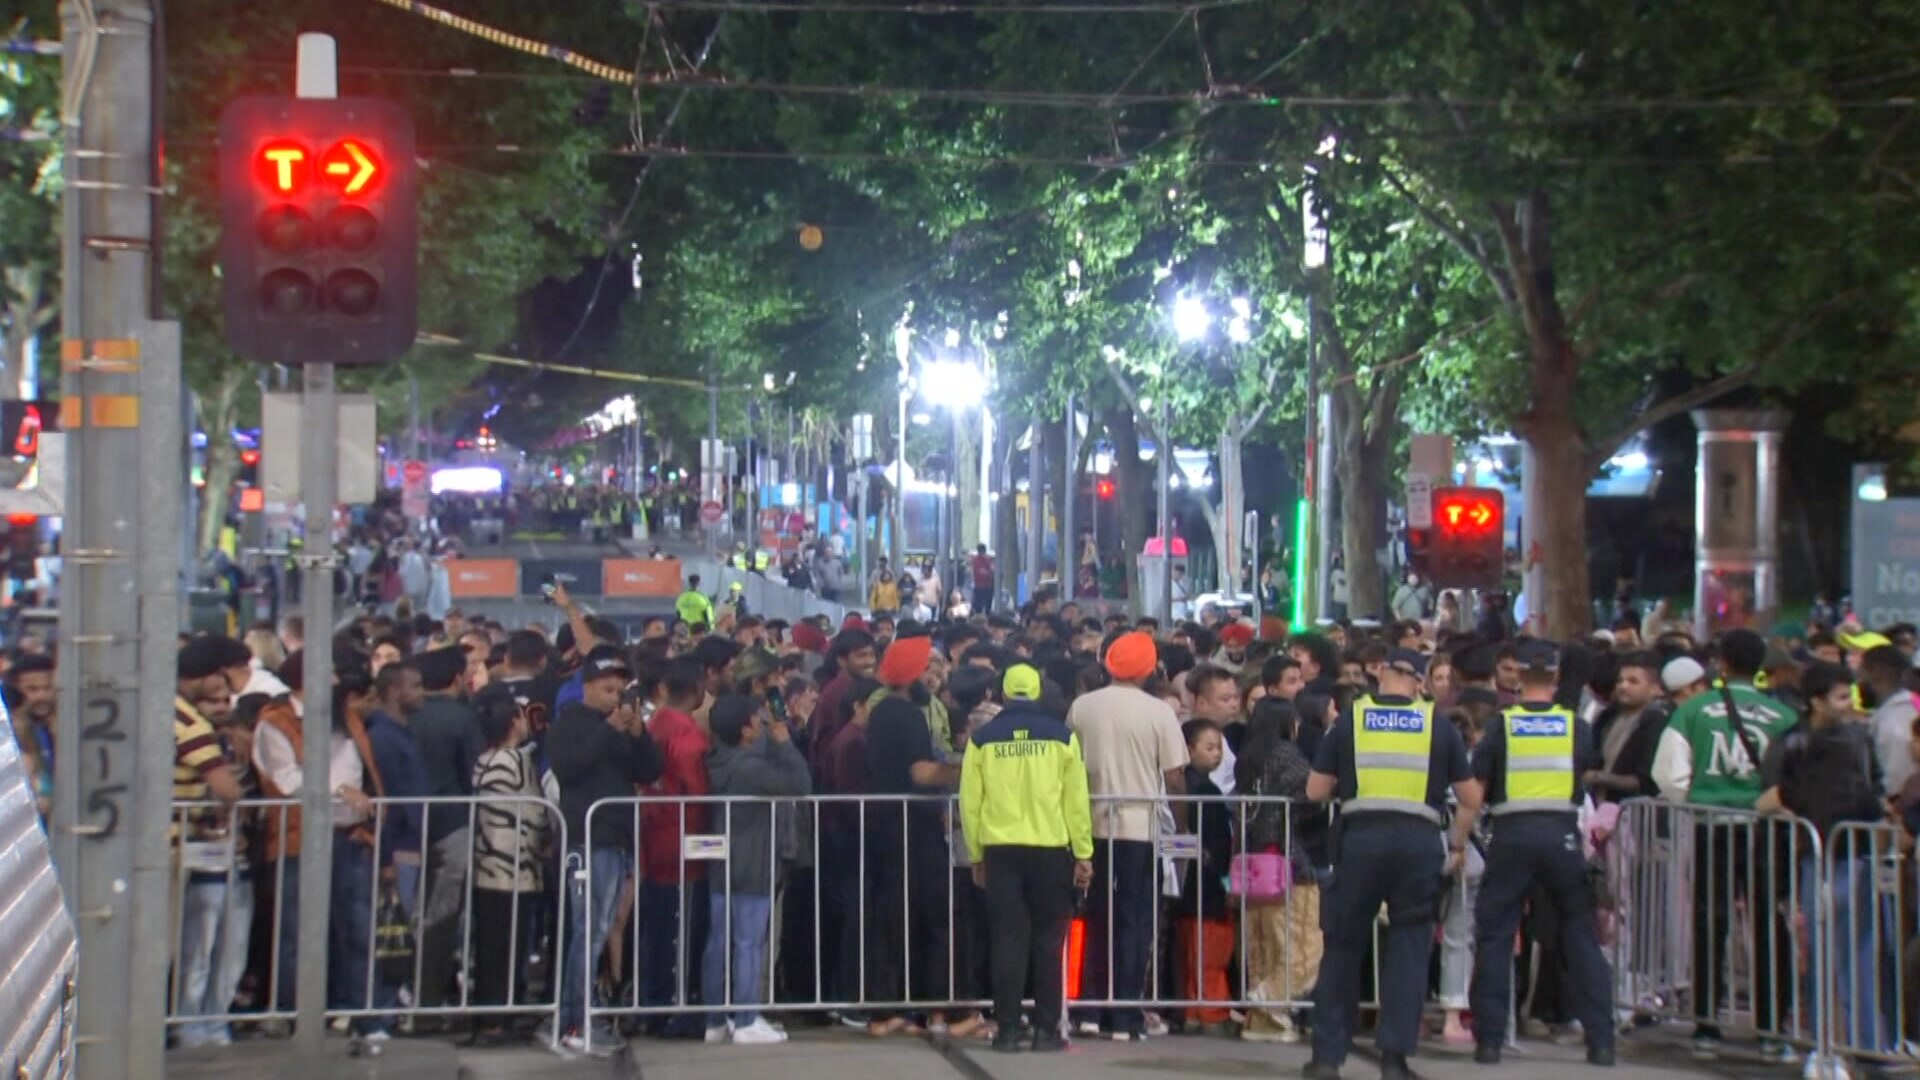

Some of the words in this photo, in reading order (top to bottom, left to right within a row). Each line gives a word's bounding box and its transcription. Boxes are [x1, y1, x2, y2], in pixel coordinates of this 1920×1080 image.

[265, 149, 303, 190] T
[1365, 711, 1423, 729] Police
[1511, 717, 1566, 734] Police
[994, 742, 1047, 758] SECURITY
